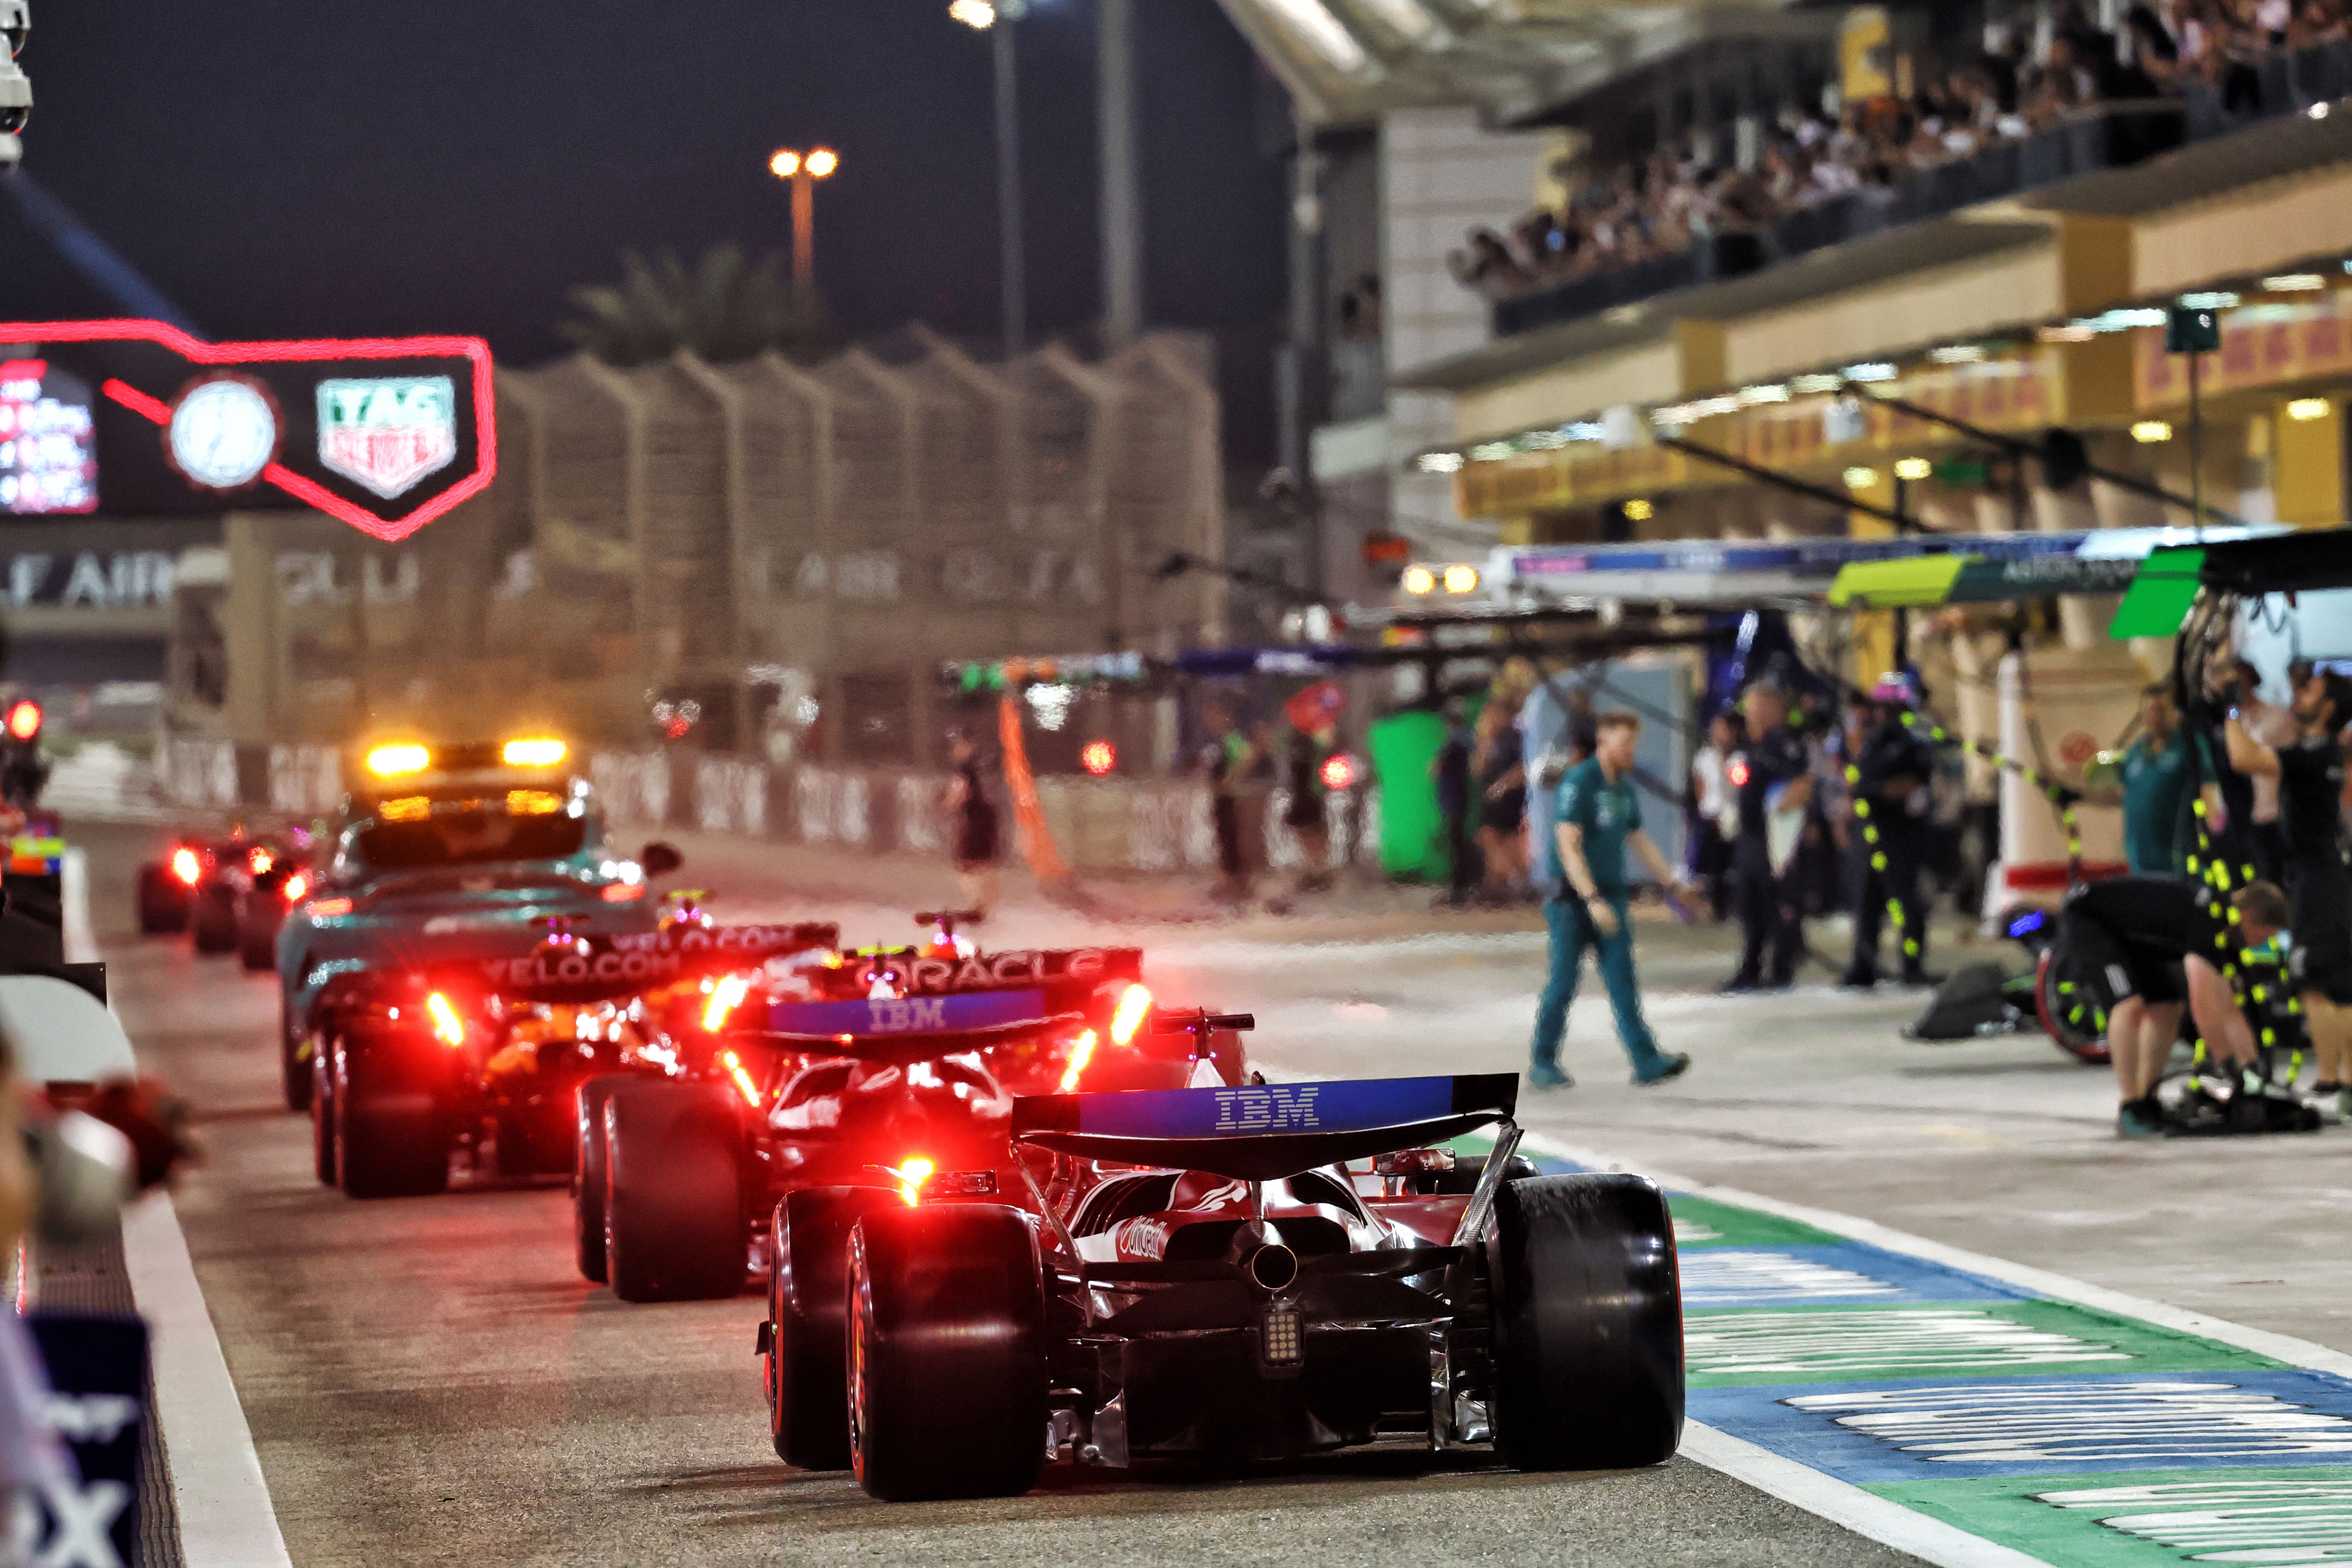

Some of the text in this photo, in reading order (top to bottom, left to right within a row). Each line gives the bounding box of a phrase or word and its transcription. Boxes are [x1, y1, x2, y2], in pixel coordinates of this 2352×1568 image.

[327, 386, 440, 426] TAG
[855, 948, 1106, 992] ORACLE
[868, 998, 946, 1032] IBM
[1215, 1087, 1319, 1130] IBM
